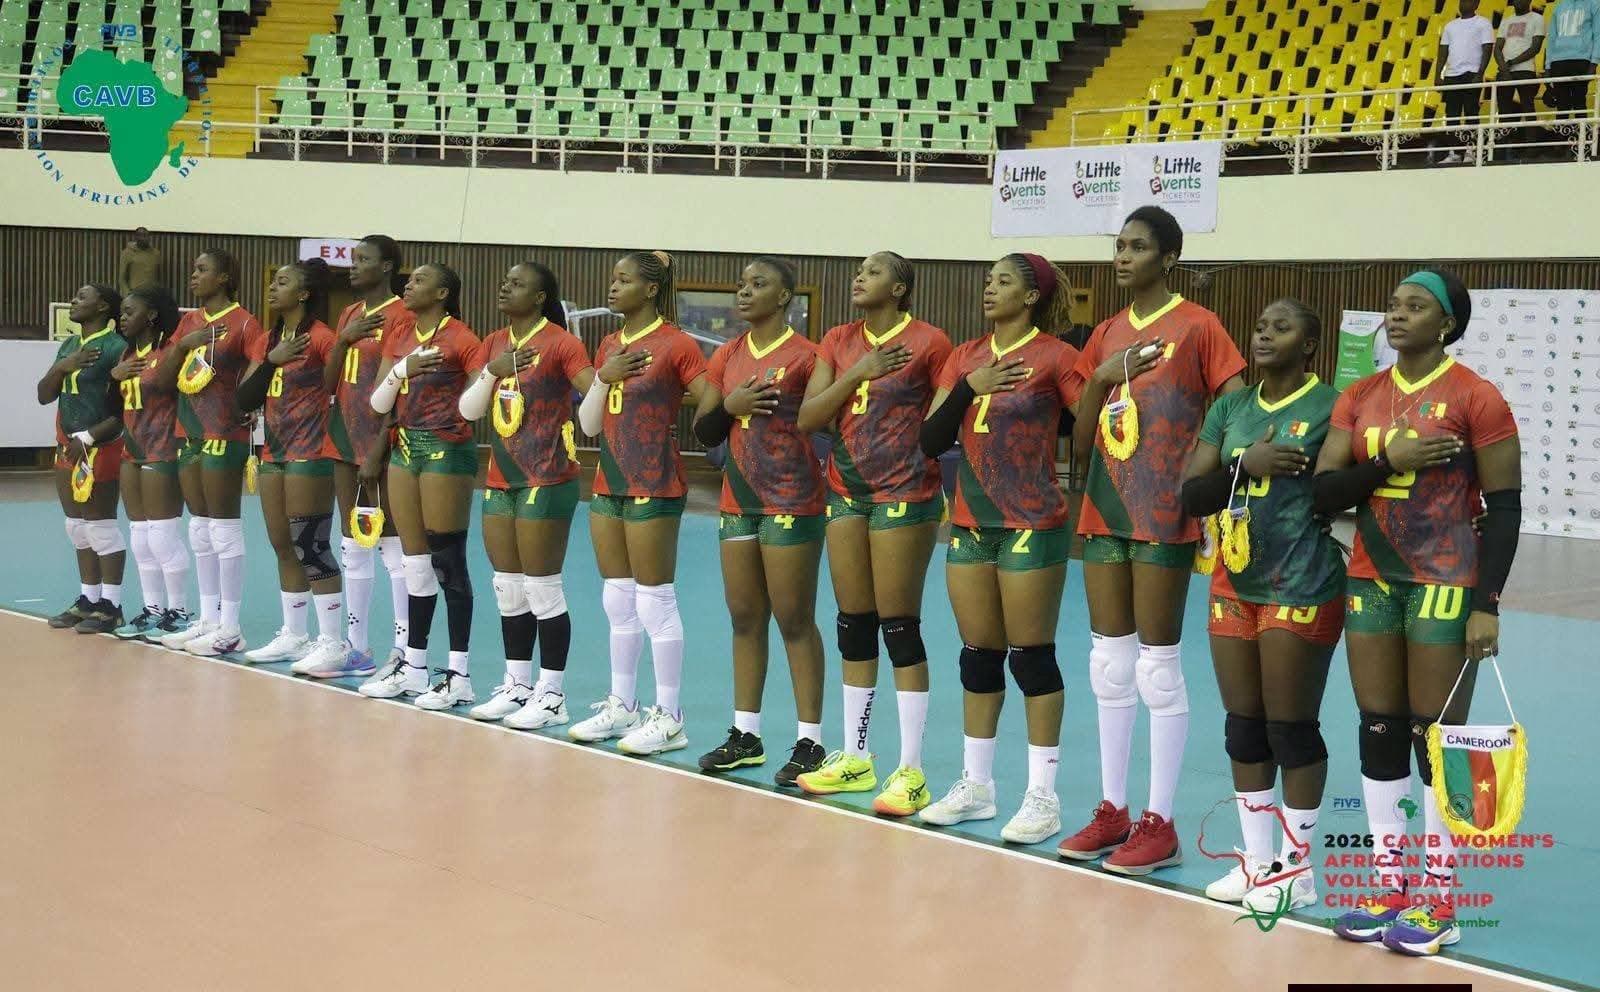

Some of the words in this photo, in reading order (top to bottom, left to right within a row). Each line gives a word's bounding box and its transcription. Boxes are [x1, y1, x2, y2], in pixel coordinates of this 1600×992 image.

[1012, 166, 1047, 182] Little
[1086, 160, 1121, 178] Little
[1163, 157, 1201, 174] Little
[1000, 184, 1047, 202] events
[1073, 180, 1121, 199] events
[1150, 176, 1201, 194] events
[973, 393, 992, 433] 2
[1417, 584, 1464, 620] 10
[1446, 734, 1512, 749] CAMEROON
